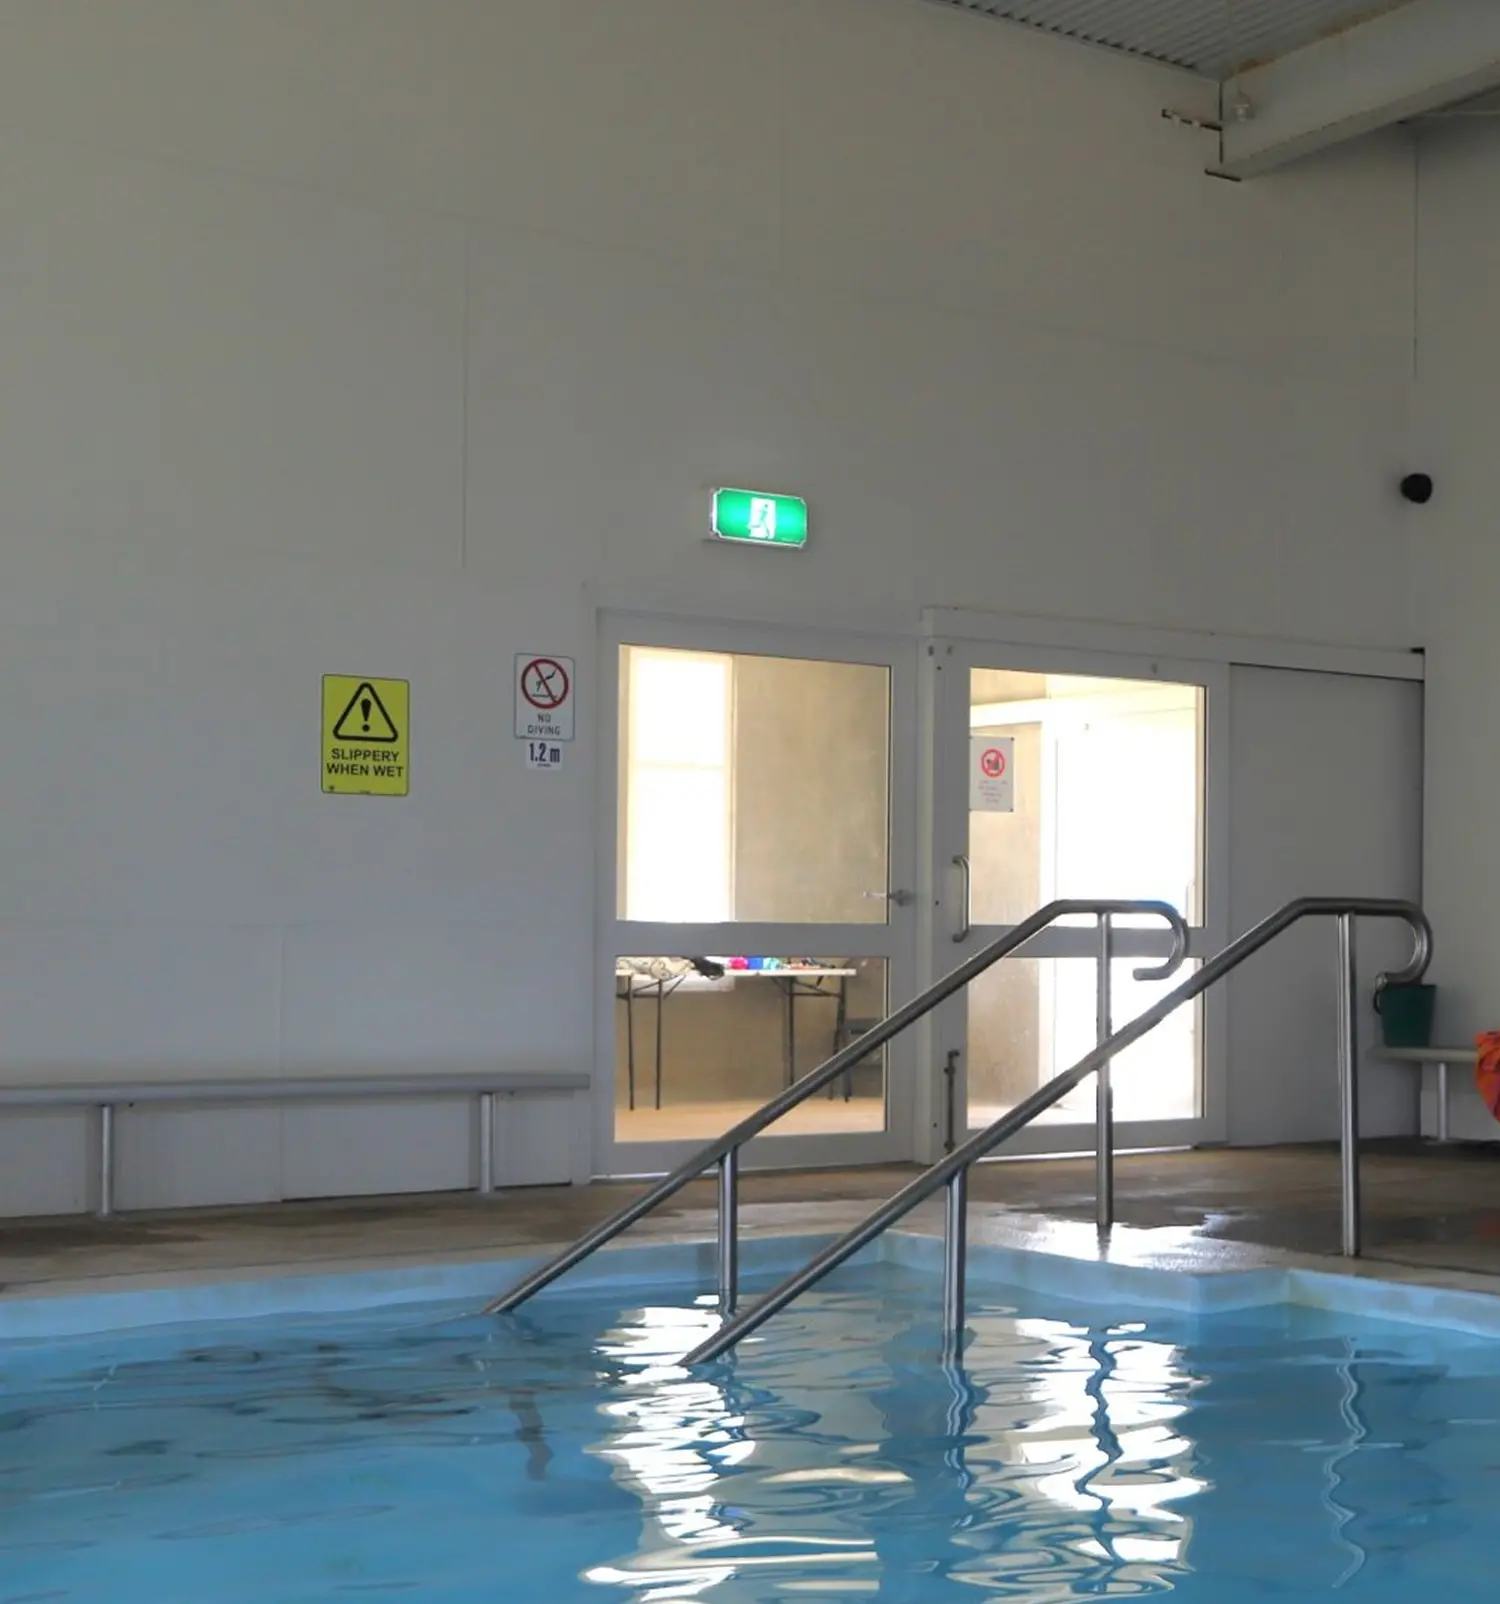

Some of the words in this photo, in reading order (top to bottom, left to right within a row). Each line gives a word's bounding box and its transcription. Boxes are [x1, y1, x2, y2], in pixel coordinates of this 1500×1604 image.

[537, 713, 551, 723] NO
[527, 724, 560, 736] DIVING
[331, 748, 399, 762] SLIPPERY
[529, 742, 547, 762] 1.2
[549, 747, 560, 764] m
[326, 762, 369, 776] WHEN
[373, 765, 404, 777] WET
